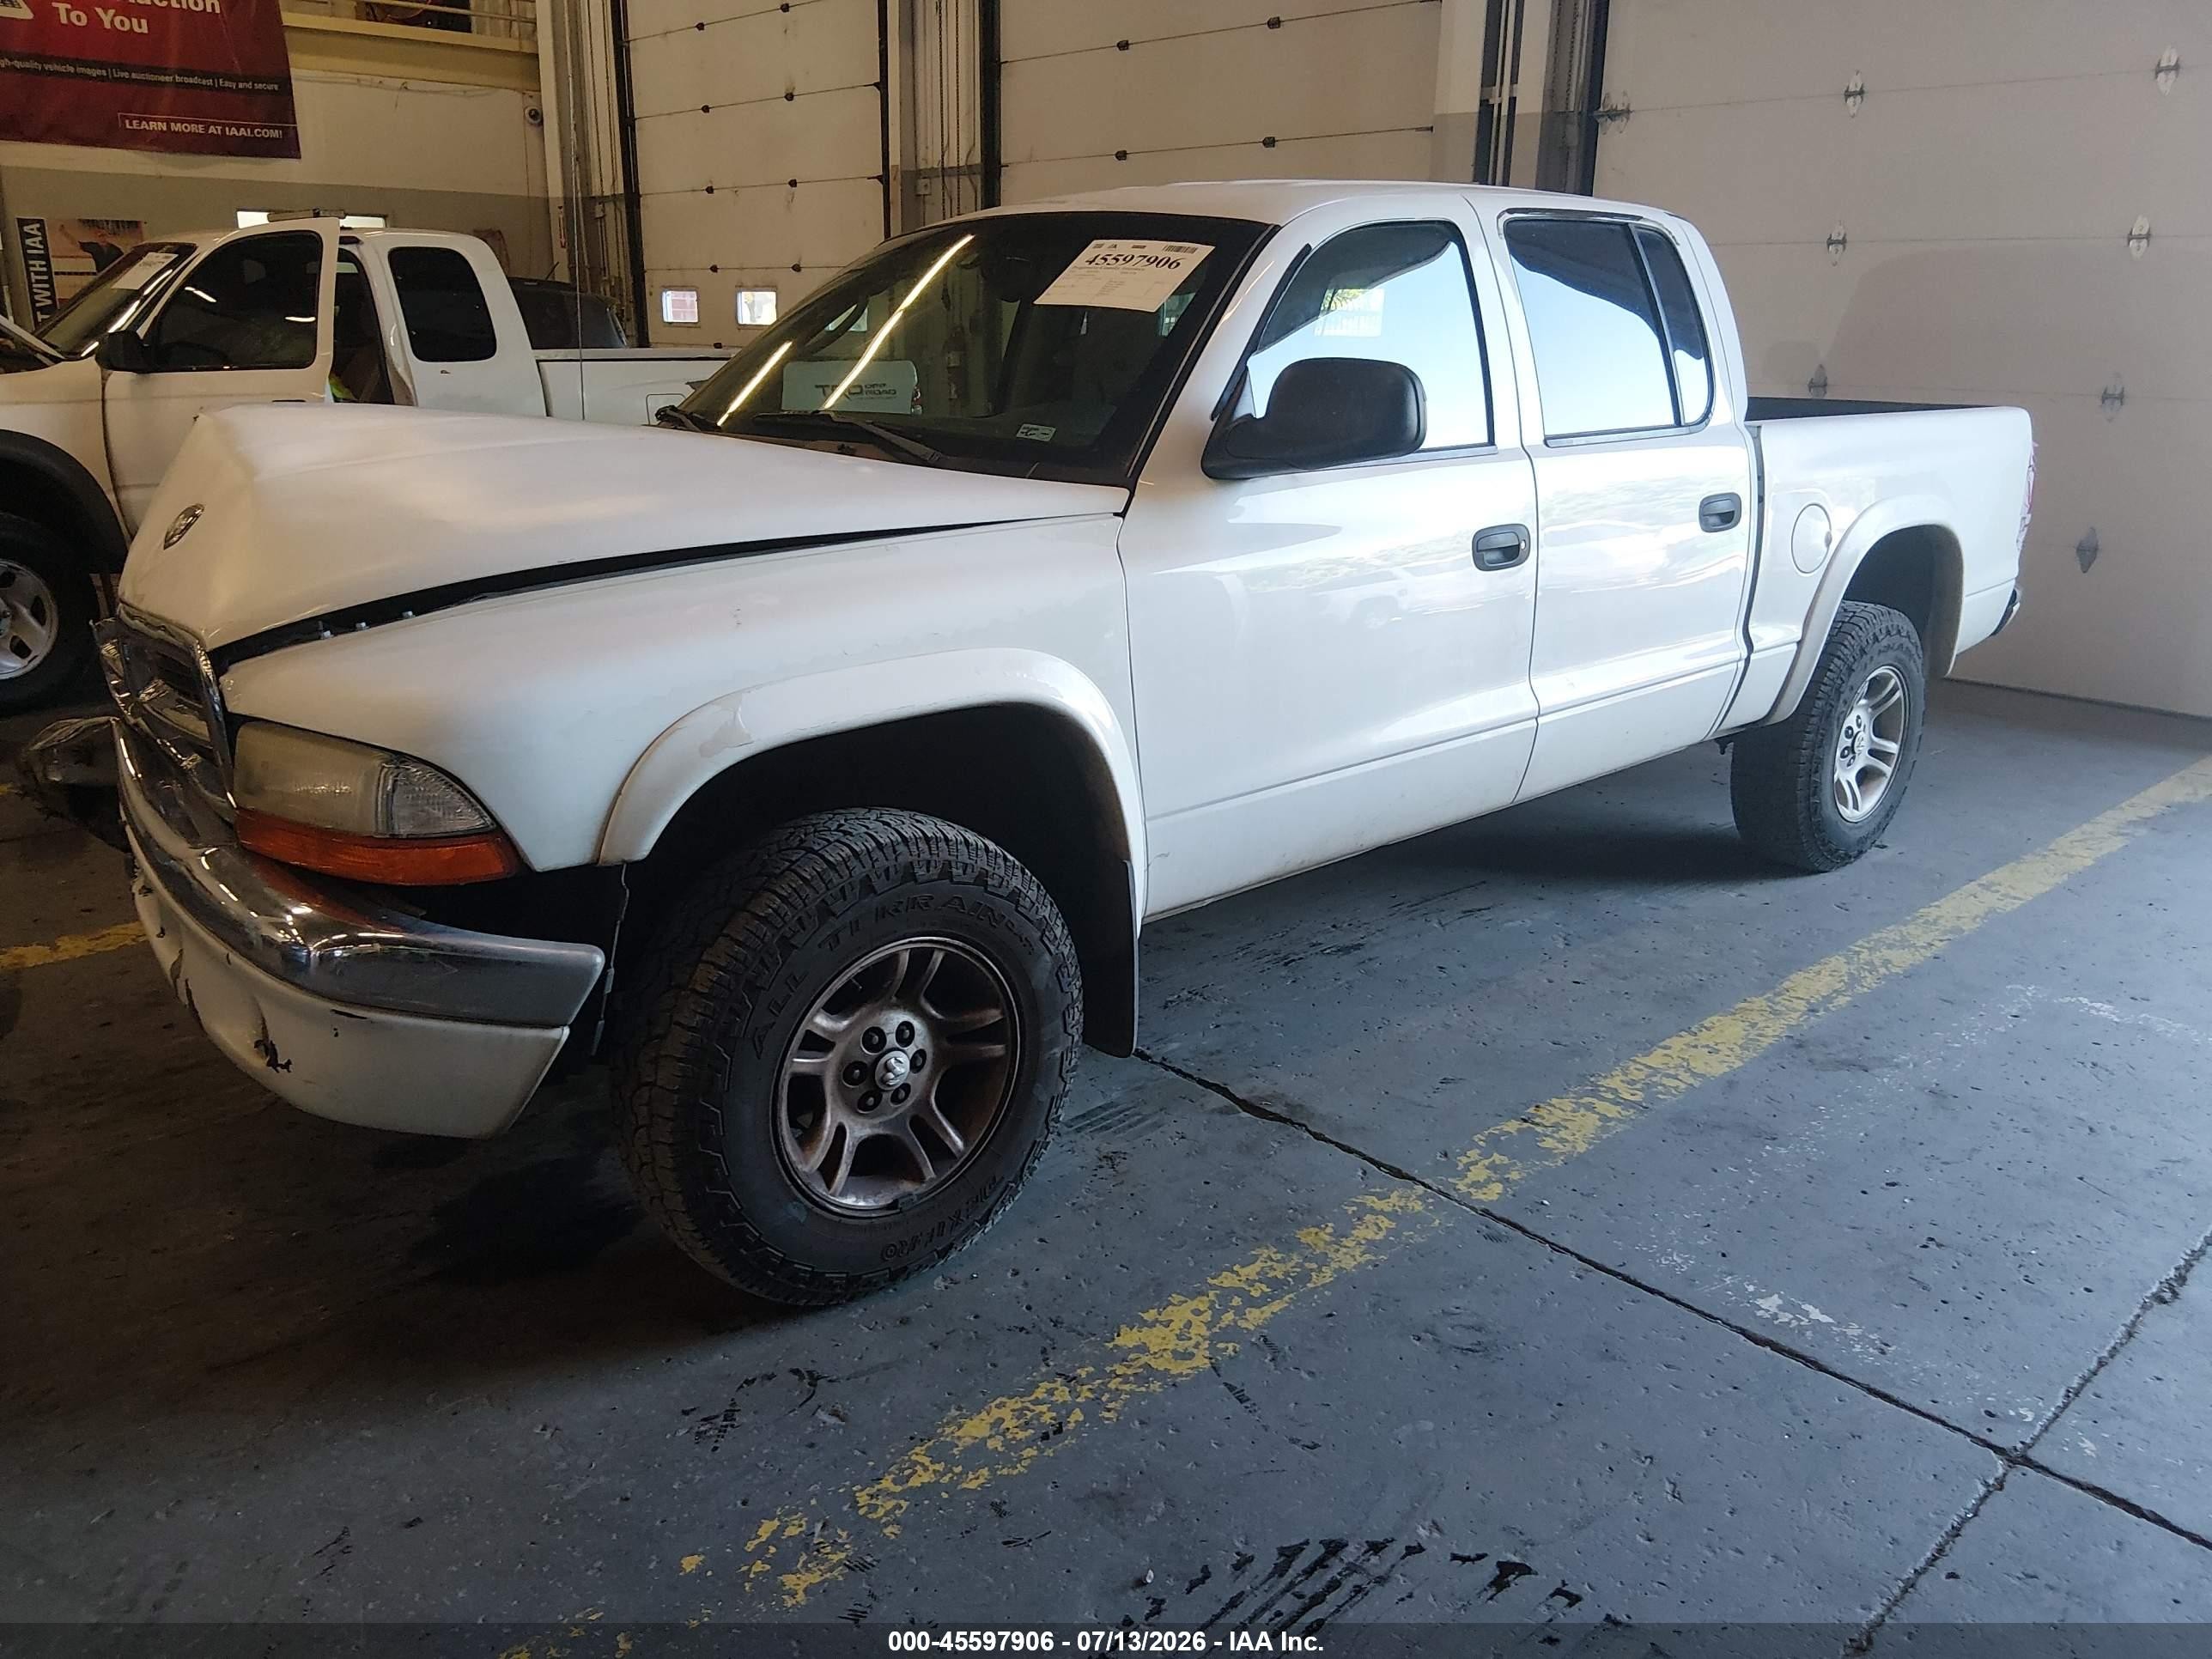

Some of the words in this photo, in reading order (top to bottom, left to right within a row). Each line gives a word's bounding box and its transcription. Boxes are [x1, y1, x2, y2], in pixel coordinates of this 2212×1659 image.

[52, 2, 88, 27] To
[94, 7, 149, 33] You
[128, 0, 221, 14] ction
[44, 64, 74, 73] vehicle
[76, 66, 106, 77] images
[112, 69, 130, 79] Live
[131, 72, 173, 82] auctioneer
[175, 75, 213, 86] broadcast
[220, 78, 236, 89] Easy
[125, 119, 167, 131] LEARN
[171, 122, 205, 134] MORE
[209, 125, 222, 136] AT
[23, 222, 45, 254] IAA
[1085, 253, 1187, 270] 45597906
[27, 260, 52, 307] WITH
